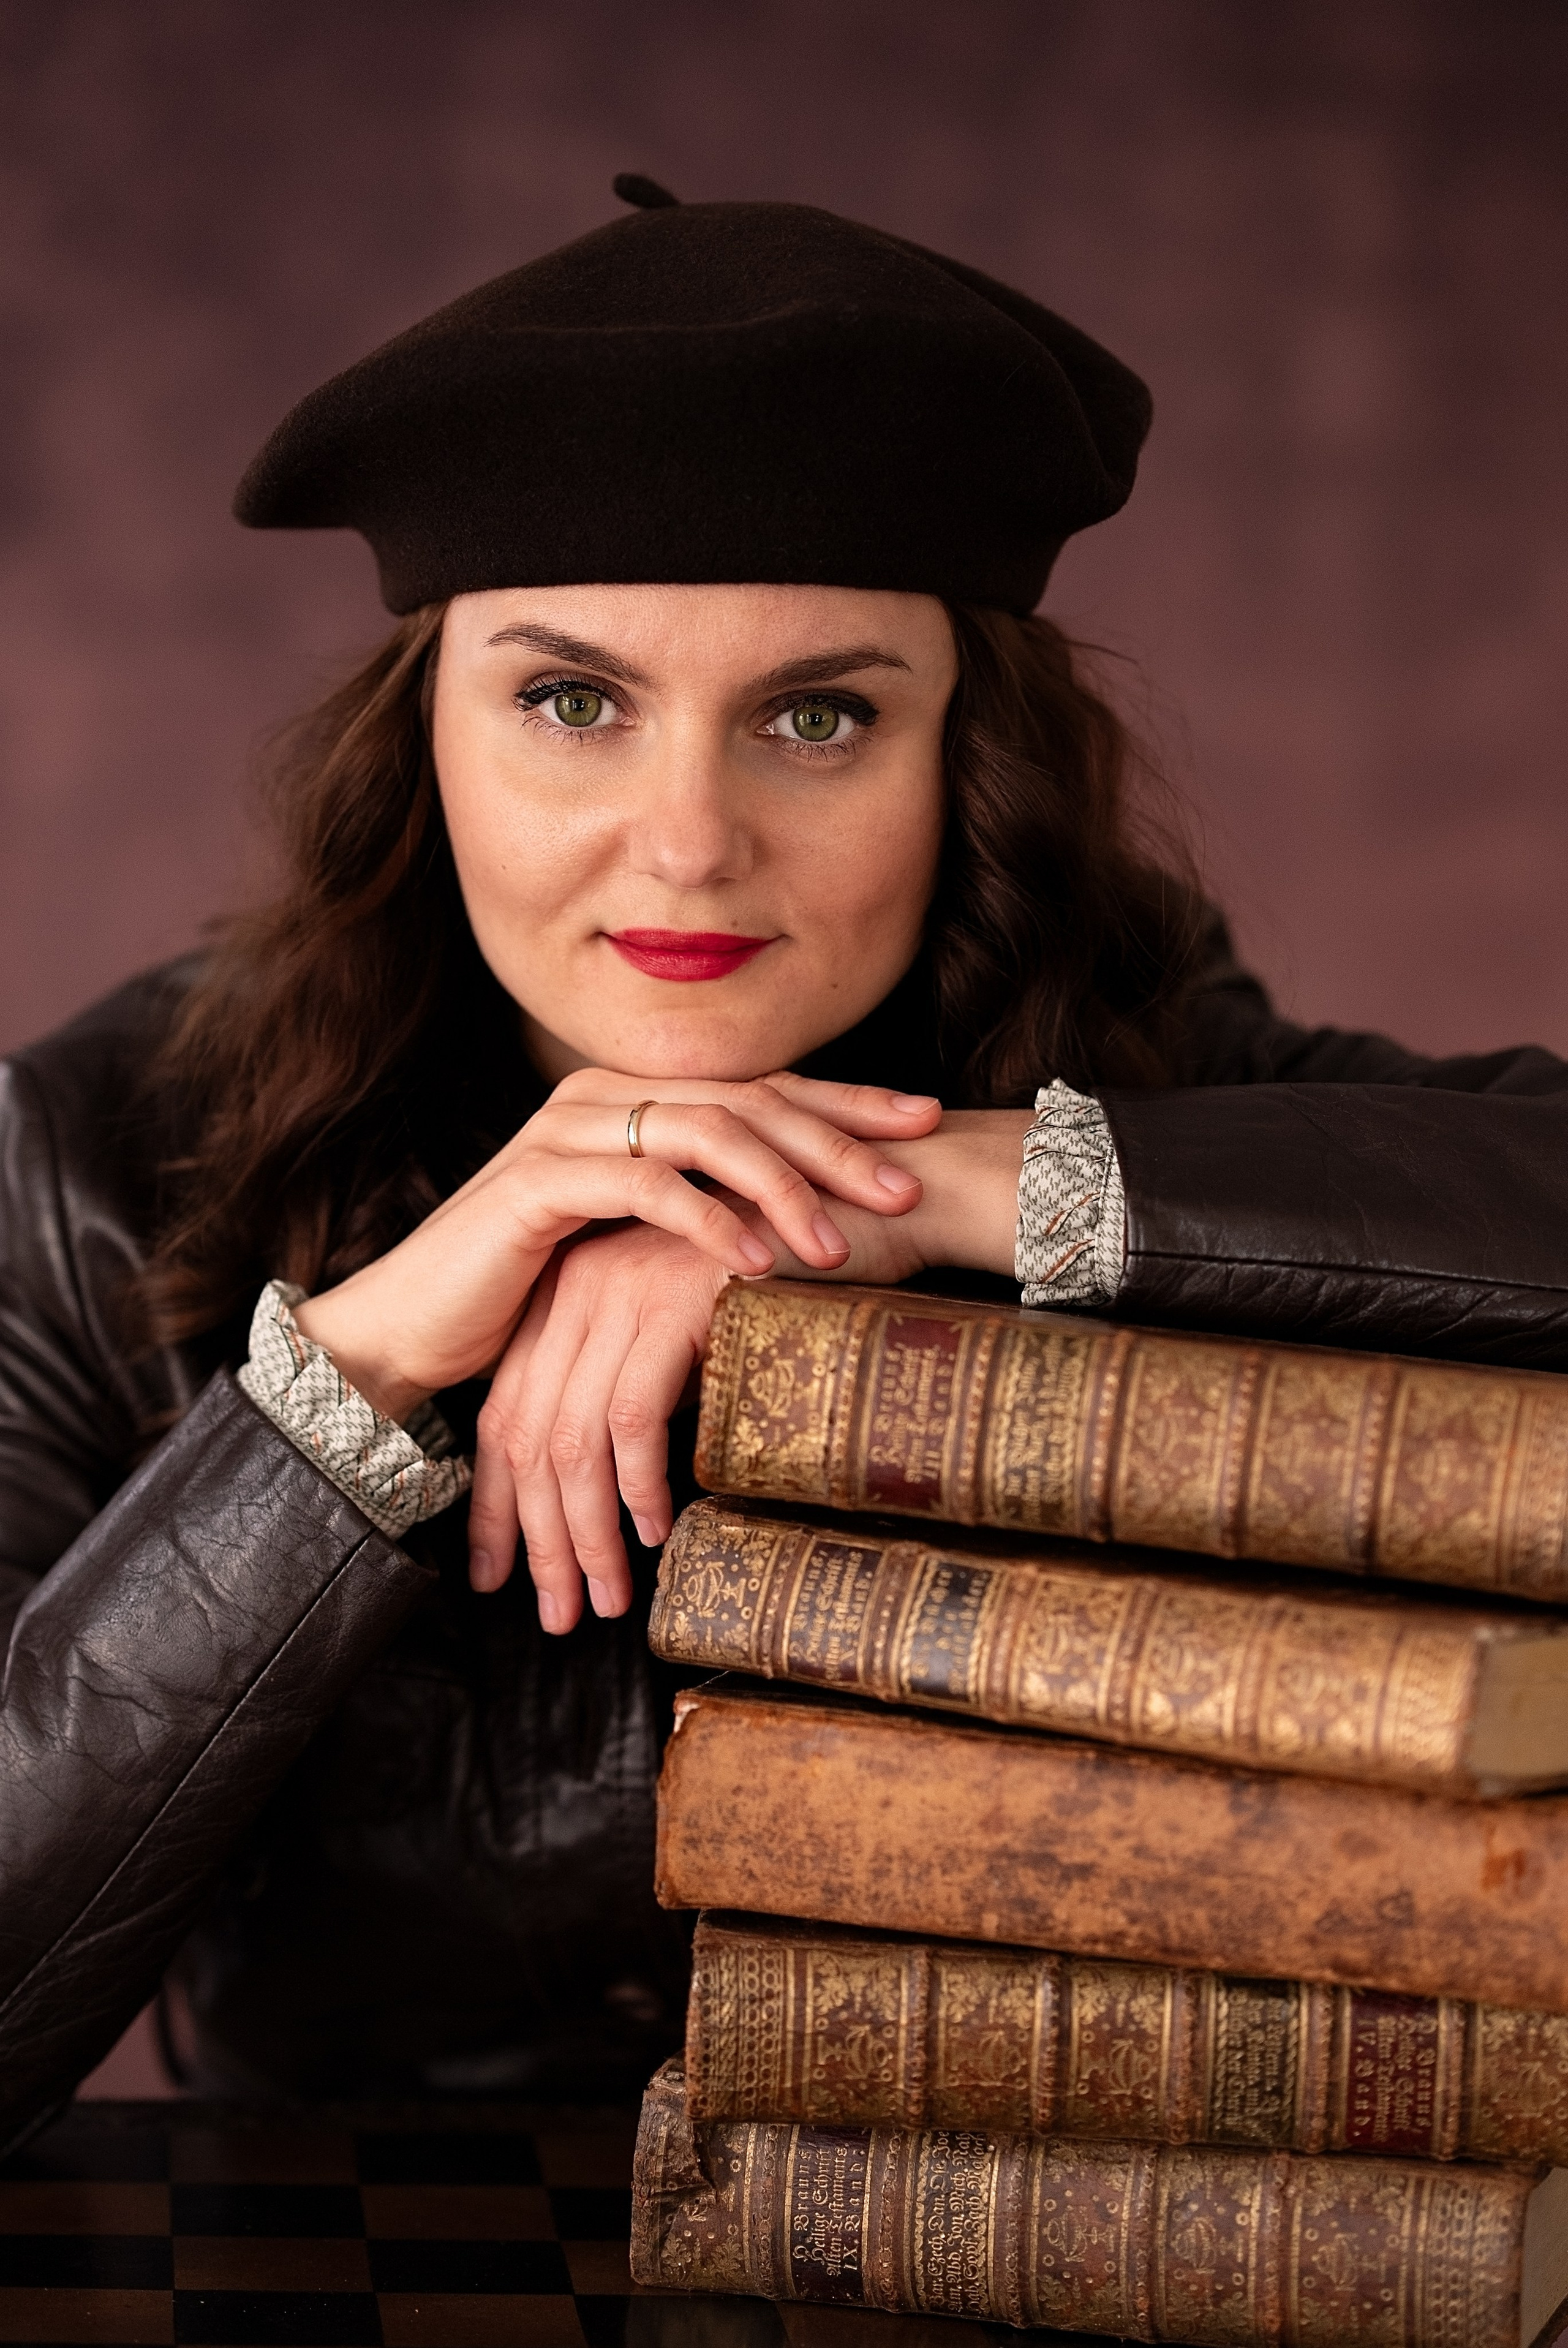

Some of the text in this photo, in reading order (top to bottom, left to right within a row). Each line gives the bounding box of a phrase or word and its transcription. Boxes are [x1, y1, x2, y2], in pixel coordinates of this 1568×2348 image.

[814, 1556, 843, 1612] Schrift
[793, 2141, 816, 2231] Brauns,
[810, 2148, 831, 2265] Heilige Schrift
[948, 2167, 968, 2211] Mich.
[927, 2193, 946, 2231] Dan.
[947, 2213, 965, 2247] Jon.
[826, 2237, 842, 2276] Alten
[842, 2237, 859, 2270] IX.
[927, 2232, 946, 2276] Ezech.
[946, 2248, 962, 2283] Abd.
